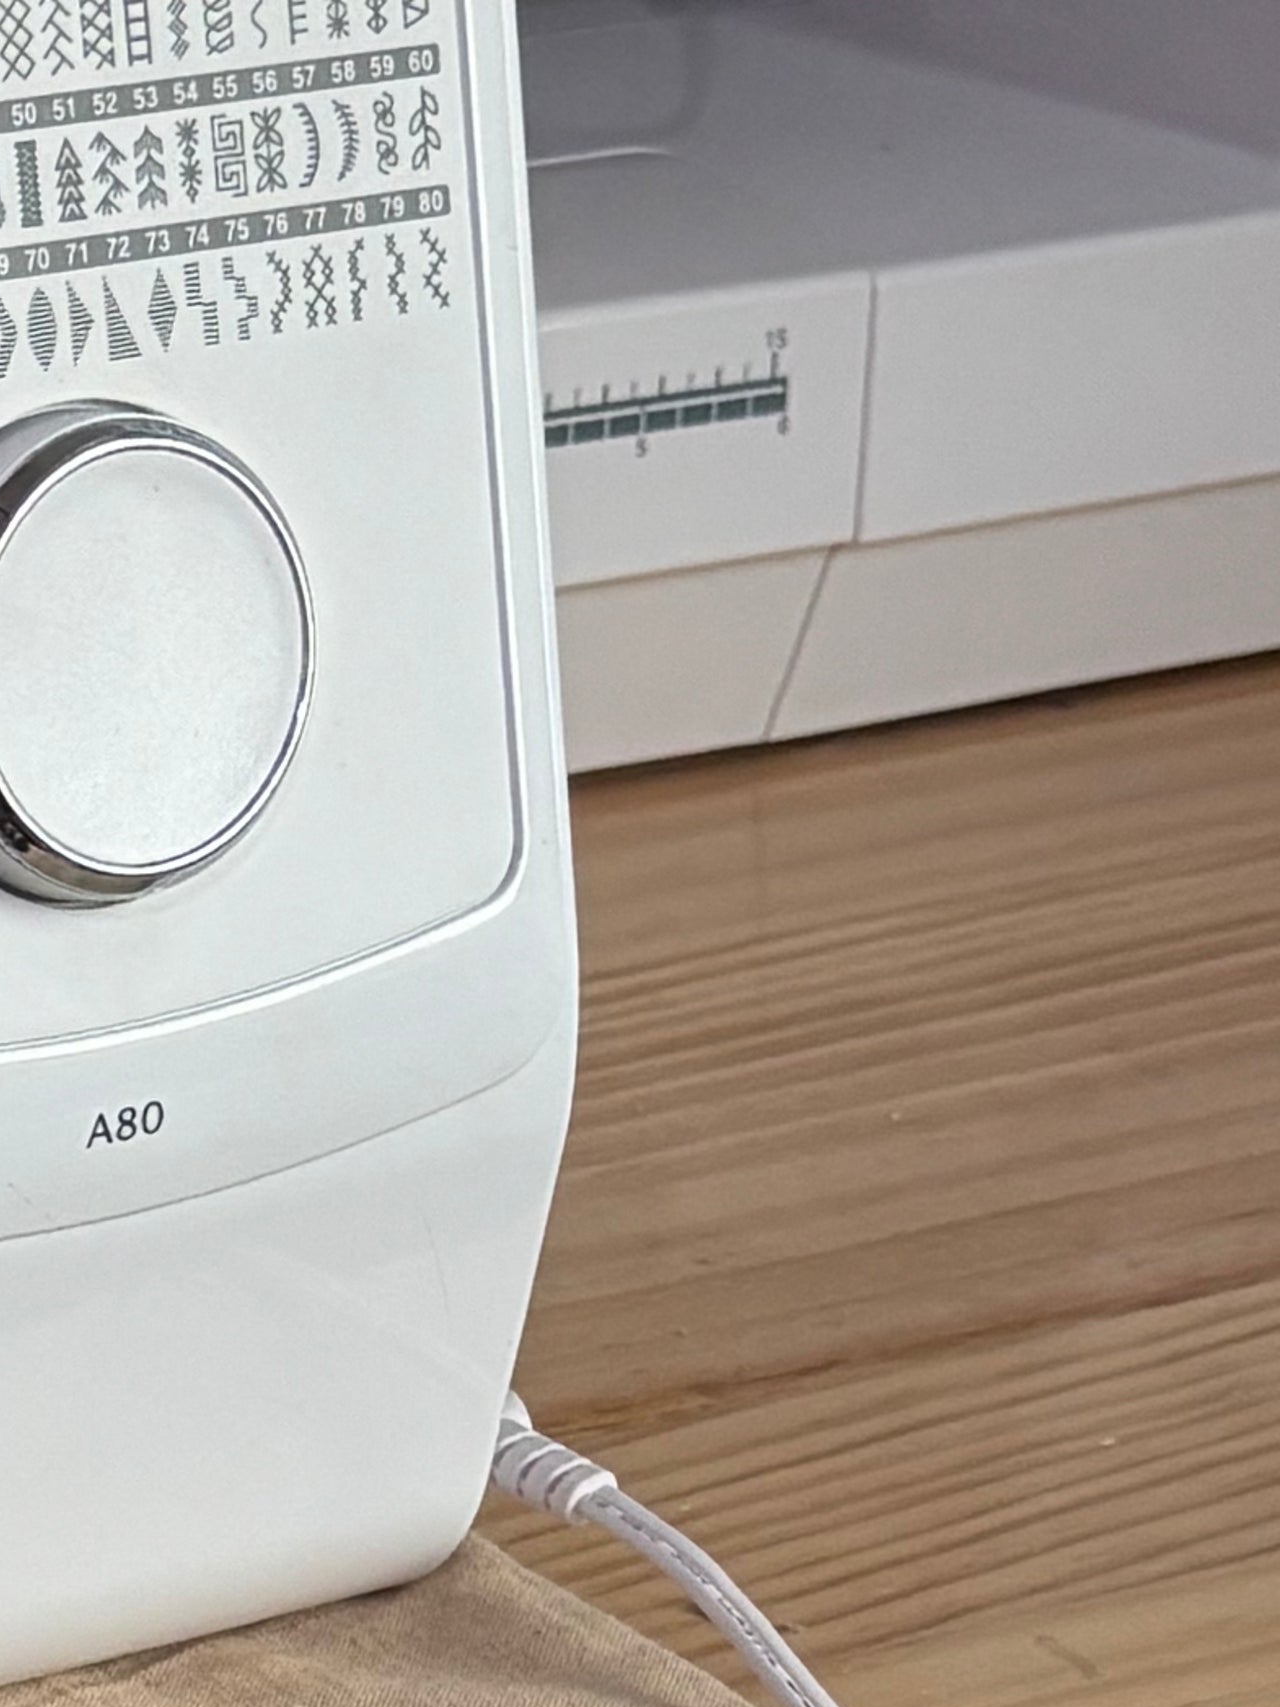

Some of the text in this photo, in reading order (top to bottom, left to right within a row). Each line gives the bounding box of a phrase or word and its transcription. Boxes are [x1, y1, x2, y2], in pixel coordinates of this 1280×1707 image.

[10, 102, 37, 127] 50
[51, 97, 76, 121] 51
[91, 91, 118, 116] 52
[132, 85, 159, 110] 53
[172, 80, 199, 105] 54
[211, 74, 238, 99] 55
[251, 69, 277, 94] 56
[291, 64, 316, 89] 57
[330, 59, 356, 84] 58
[369, 54, 395, 78] 59
[407, 49, 434, 73] 60
[23, 246, 50, 272] 70
[64, 241, 88, 266] 71
[105, 235, 131, 260] 72
[143, 229, 171, 254] 73
[184, 223, 210, 248] 74
[223, 217, 250, 242] 75
[262, 212, 289, 236] 76
[302, 206, 327, 230] 77
[340, 200, 366, 225] 78
[379, 195, 405, 219] 79
[417, 189, 443, 214] 80
[85, 1100, 165, 1150] A80
